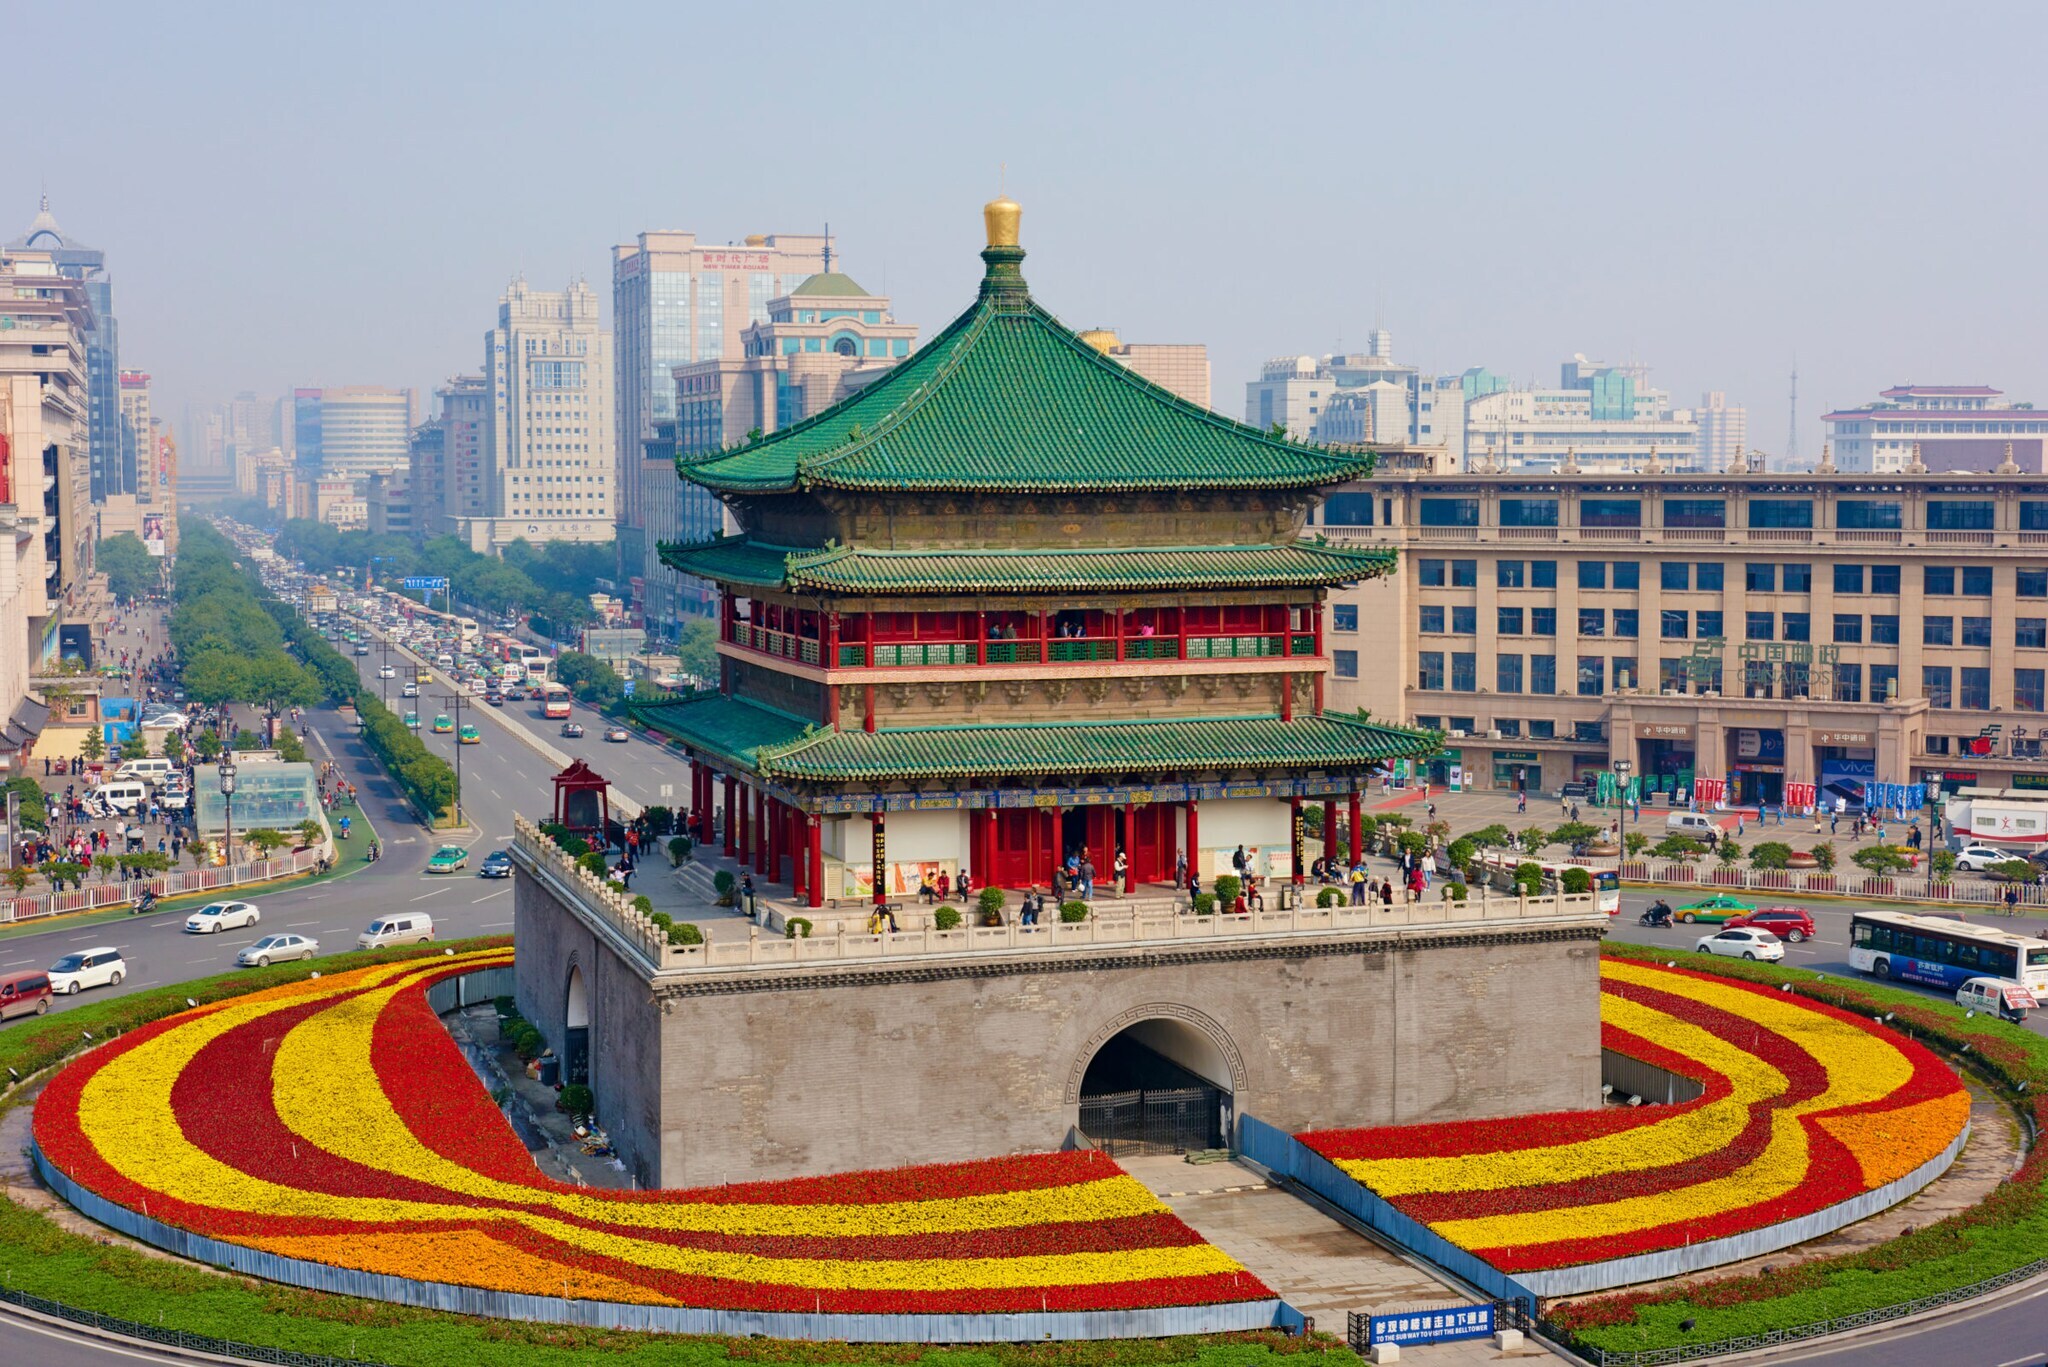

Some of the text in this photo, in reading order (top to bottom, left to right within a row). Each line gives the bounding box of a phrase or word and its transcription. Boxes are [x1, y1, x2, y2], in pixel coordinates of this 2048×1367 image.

[703, 254, 769, 263] 新时代广场
[1738, 642, 1840, 665] 中国邮政
[1737, 668, 1841, 685] CHINA POST
[1833, 733, 1866, 742] 华中通讯
[1376, 1311, 1487, 1334] 参观钟楼请走地下通道
[1385, 1334, 1395, 1342] THE
[1428, 1329, 1443, 1337] VISIT
